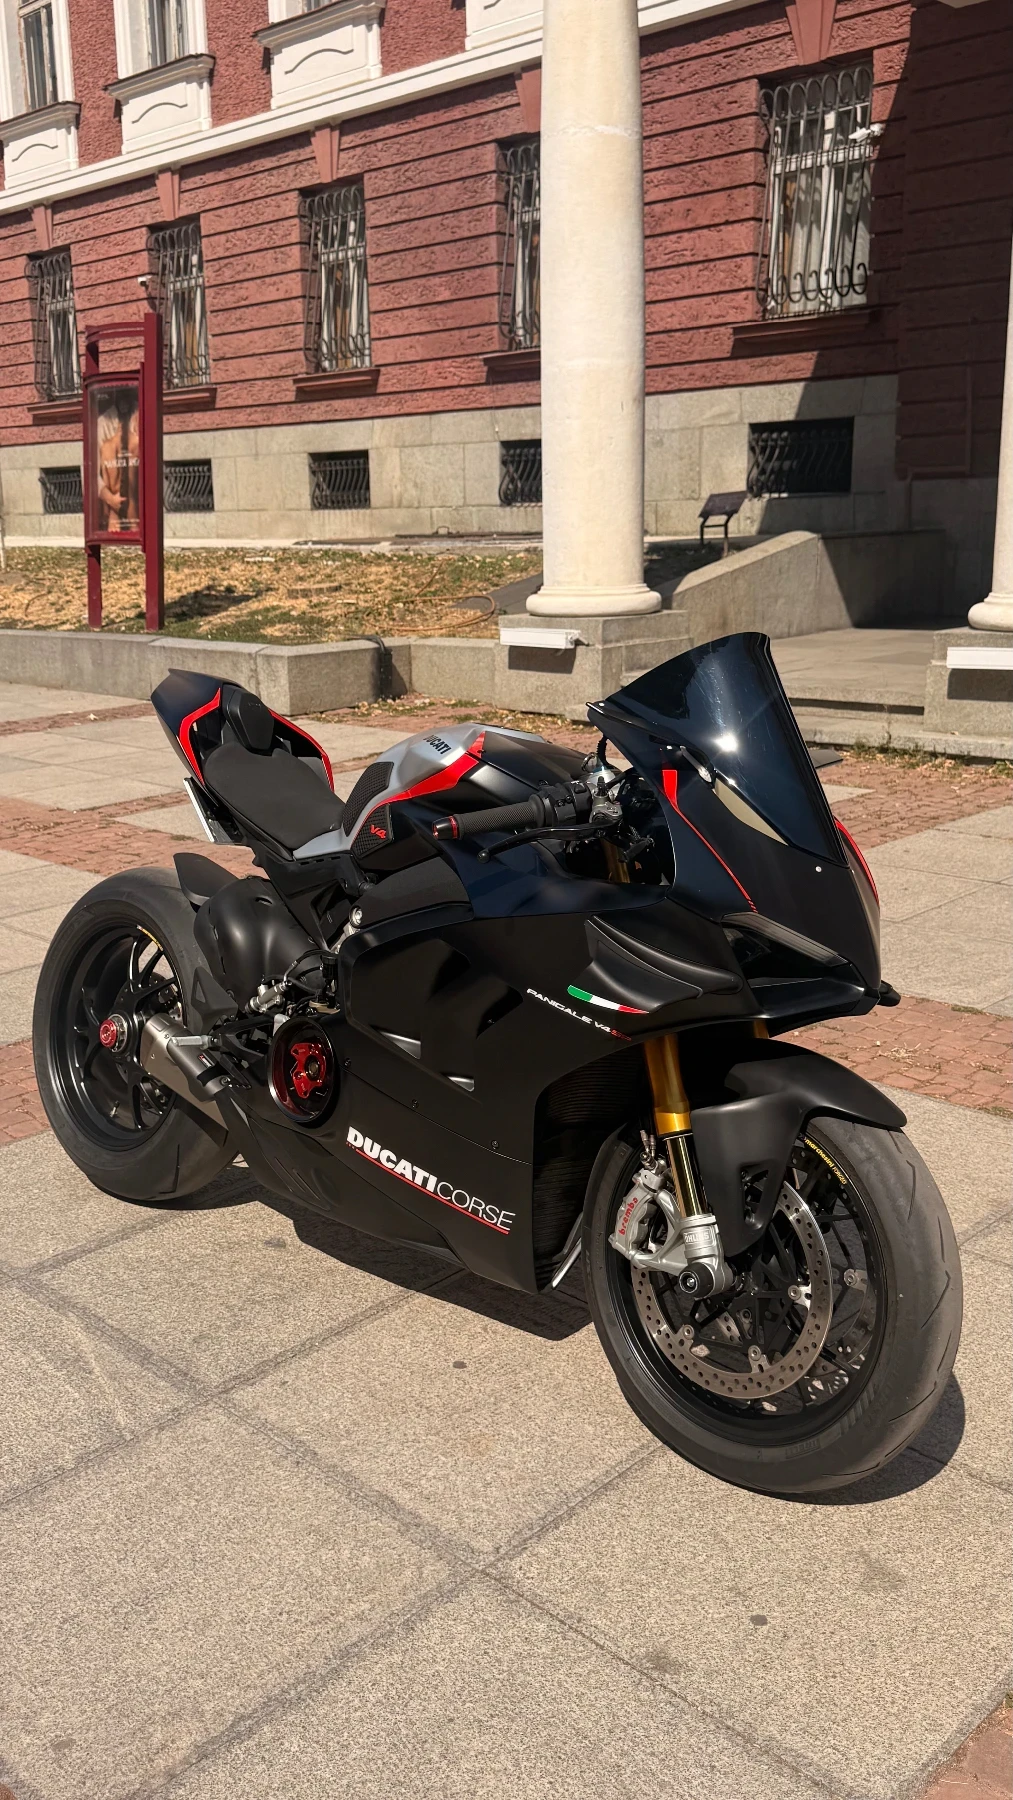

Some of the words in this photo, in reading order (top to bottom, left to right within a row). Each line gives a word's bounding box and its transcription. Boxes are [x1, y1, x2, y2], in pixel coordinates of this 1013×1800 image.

[423, 734, 451, 754] DUCATI
[370, 824, 386, 839] V4
[805, 1139, 835, 1168] marchesini
[618, 1197, 638, 1235] brembo
